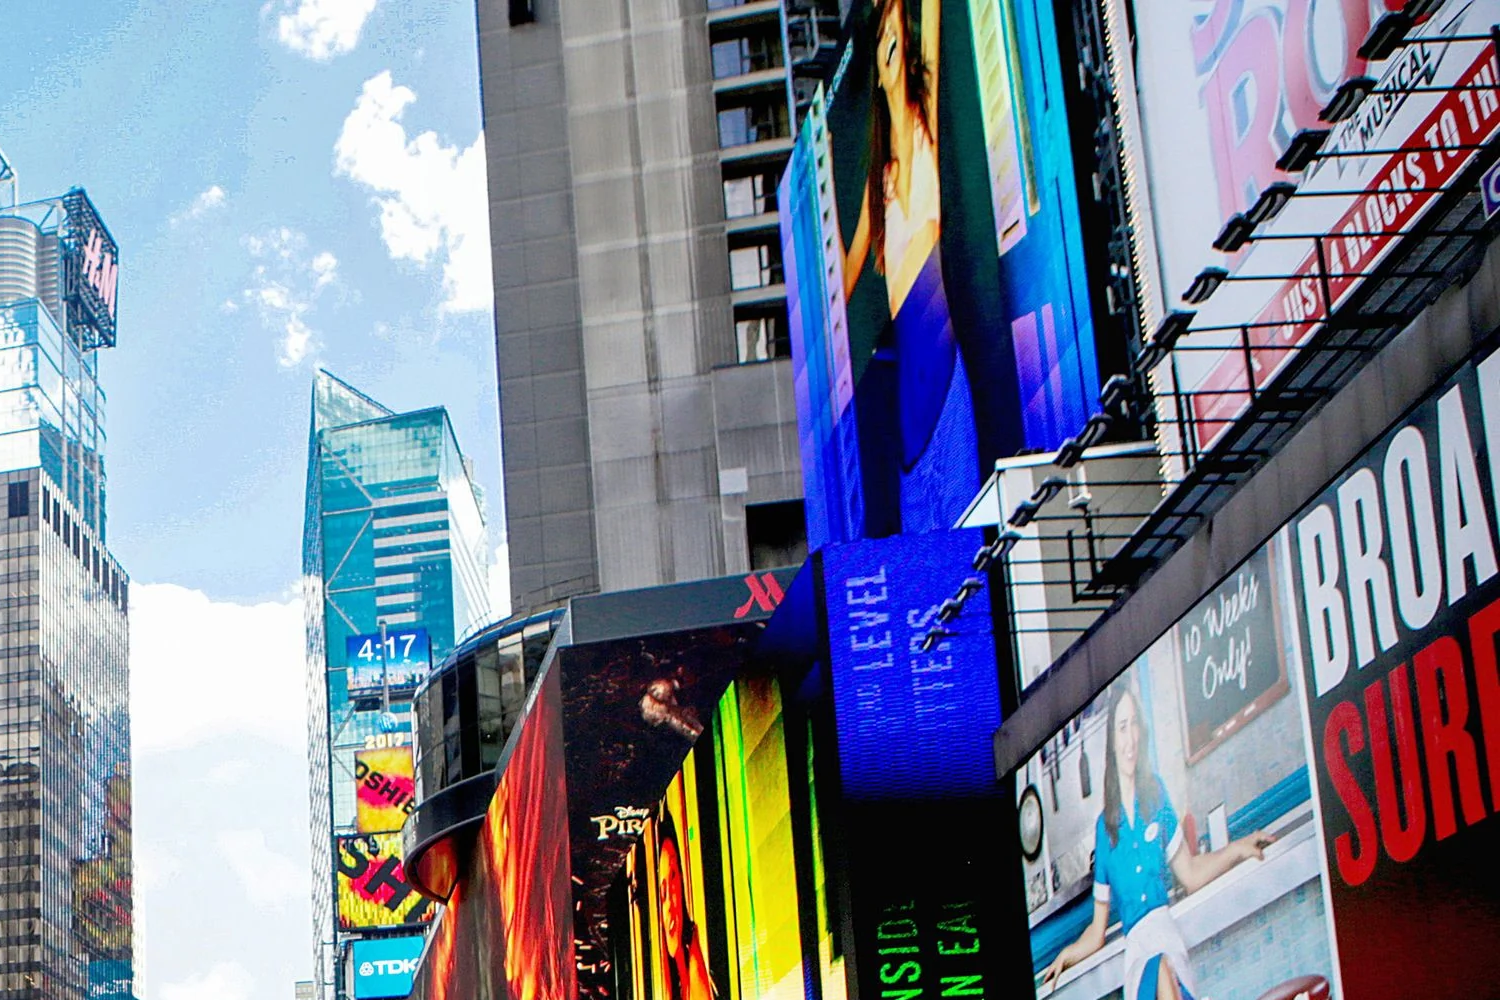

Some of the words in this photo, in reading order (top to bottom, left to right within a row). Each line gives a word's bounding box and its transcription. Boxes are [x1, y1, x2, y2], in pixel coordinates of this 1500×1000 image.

[1358, 40, 1432, 151] MUSICAL
[1279, 260, 1327, 340] JUST
[1347, 151, 1427, 271] BLOCKS
[1425, 108, 1461, 173] TO
[83, 229, 119, 318] H&M
[357, 634, 417, 662] 4:17
[1184, 624, 1202, 663] 10
[1202, 571, 1260, 638] Weeks
[1201, 625, 1253, 699] Only!
[364, 732, 405, 749] 2017
[372, 959, 417, 976] TDK
